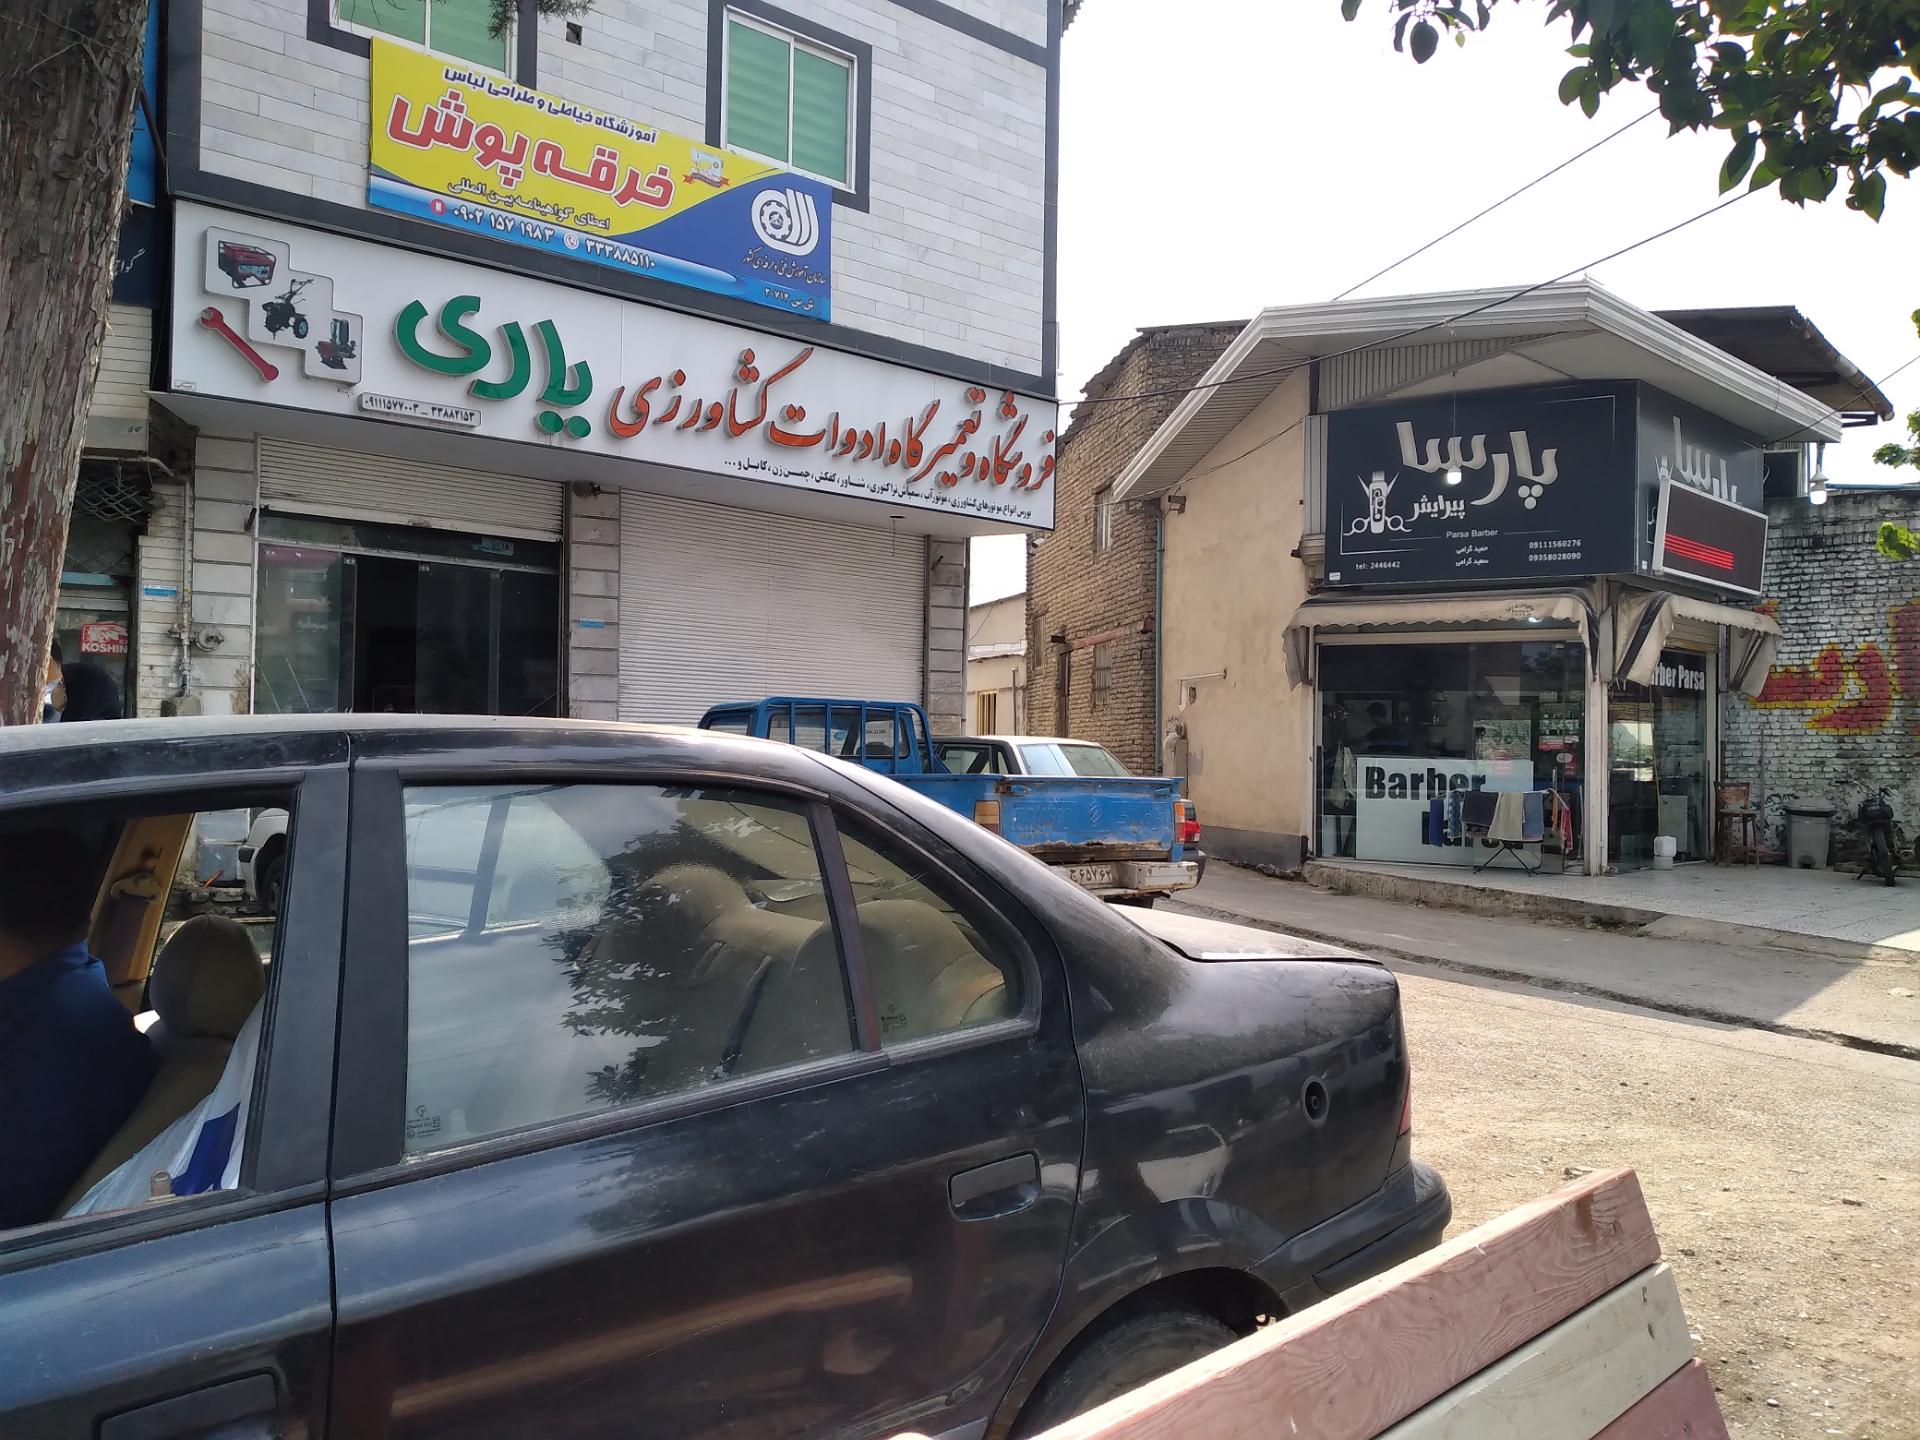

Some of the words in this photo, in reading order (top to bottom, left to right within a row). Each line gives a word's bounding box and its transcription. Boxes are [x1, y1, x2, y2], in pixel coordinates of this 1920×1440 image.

[443, 66, 487, 90] لباس
[487, 80, 536, 106] طراحی
[536, 98, 546, 111] و
[548, 101, 594, 125] خیاطی
[387, 88, 530, 189] پوش
[594, 115, 657, 144] آموزشگاه
[447, 177, 487, 197] المللی
[533, 140, 674, 209] خرقه
[487, 189, 515, 207] بین
[514, 196, 574, 222] گواهینامه
[452, 204, 484, 225] ۰۹۰۲
[489, 212, 515, 233] ۱۵۷
[519, 220, 555, 243] ۱۹۸۳
[573, 211, 611, 231] اعطای
[585, 237, 657, 269] ۳۳۳۸۸۵۱۱۰
[392, 294, 594, 439] یاری
[607, 347, 815, 438] کشاورزی
[364, 396, 419, 413] ۰۹۱۱۱۵۷۷۰۰۳
[430, 406, 475, 422] ۳۳۸۸۲۱۵۳
[765, 404, 886, 461] ادوات
[885, 387, 987, 488] تعمیرگاه
[975, 391, 1055, 491] فروشگاه
[958, 451, 976, 478] و
[1396, 421, 1558, 510] پارسا
[1446, 530, 1469, 539] Parsa
[1471, 529, 1499, 538] Barber
[82, 642, 128, 654] KOSHIN
[1678, 664, 1705, 690] Parsa
[1365, 766, 1487, 801] Barber
